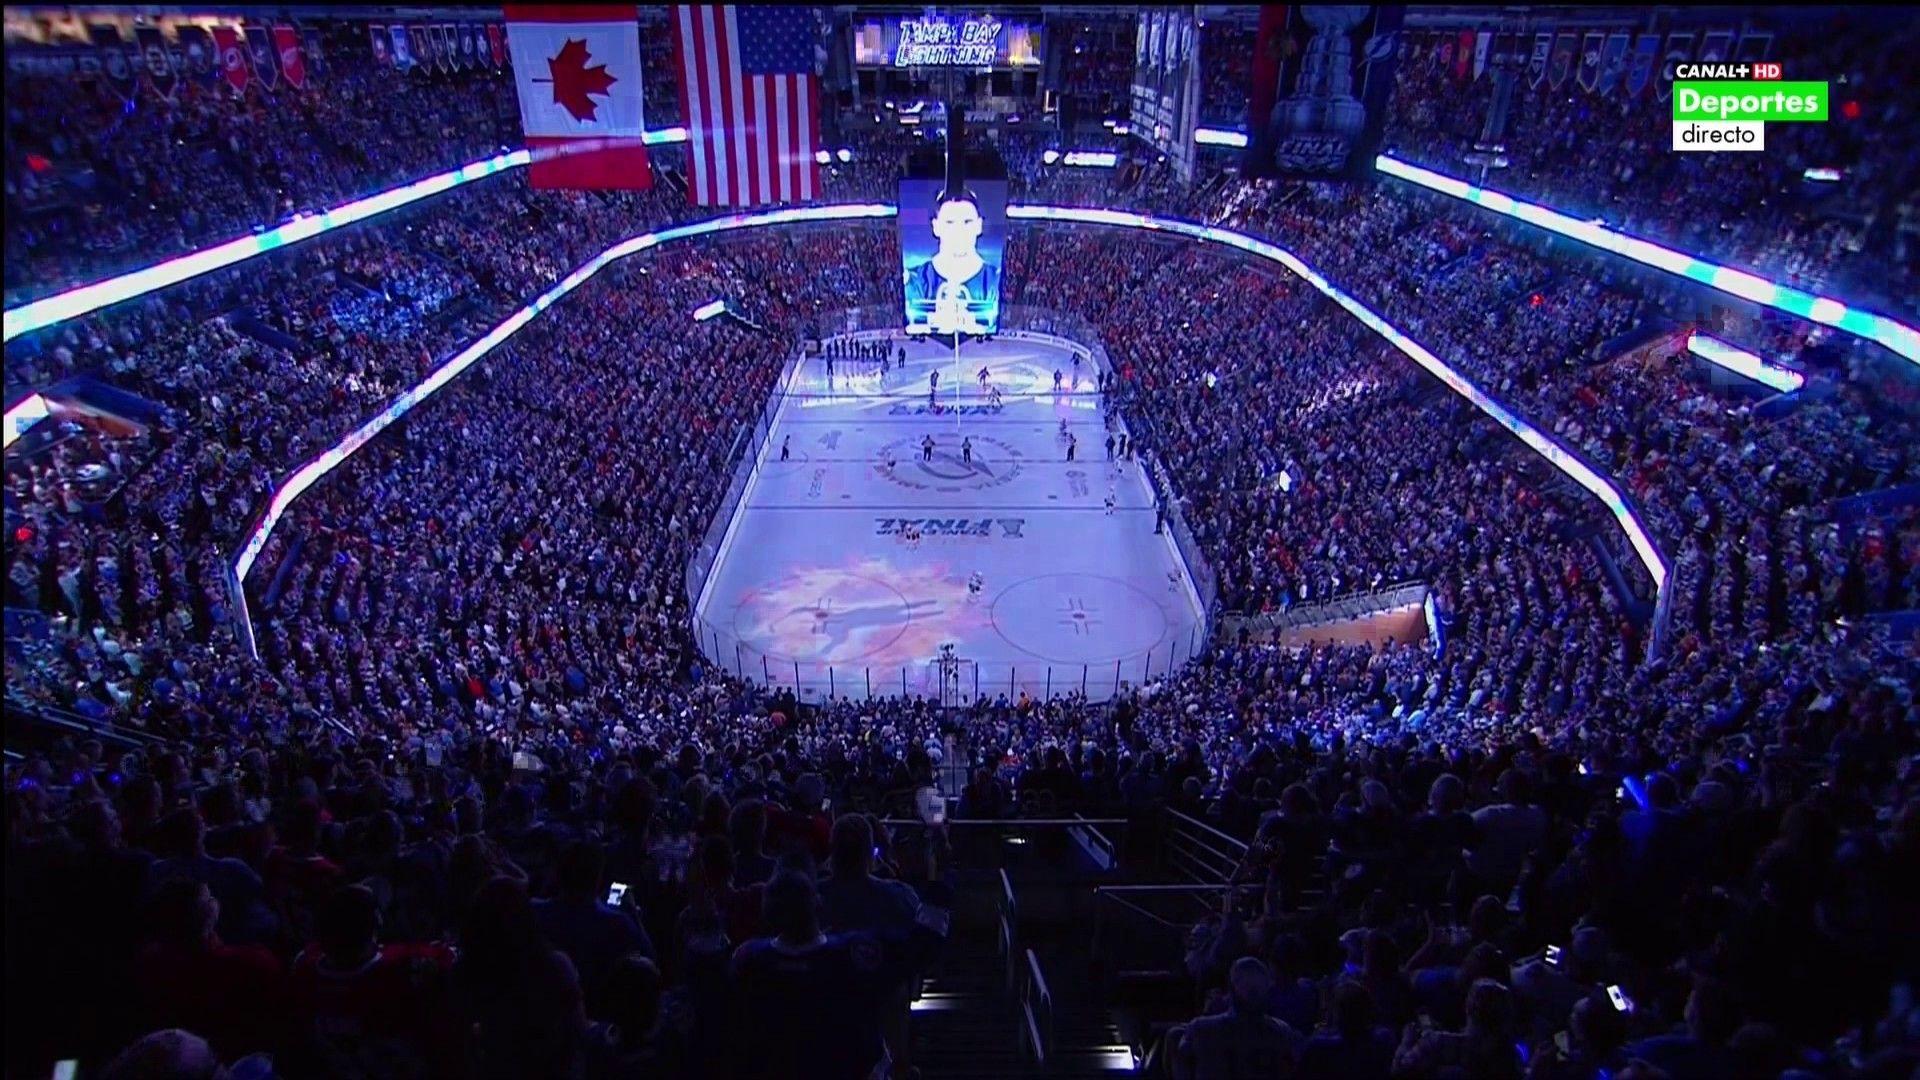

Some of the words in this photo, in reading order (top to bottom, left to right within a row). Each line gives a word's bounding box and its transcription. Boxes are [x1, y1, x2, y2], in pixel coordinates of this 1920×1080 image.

[900, 21, 957, 44] TAMPA
[962, 21, 1003, 44] BAY
[896, 44, 996, 67] LIGHTNING
[1278, 140, 1346, 155] FINAL
